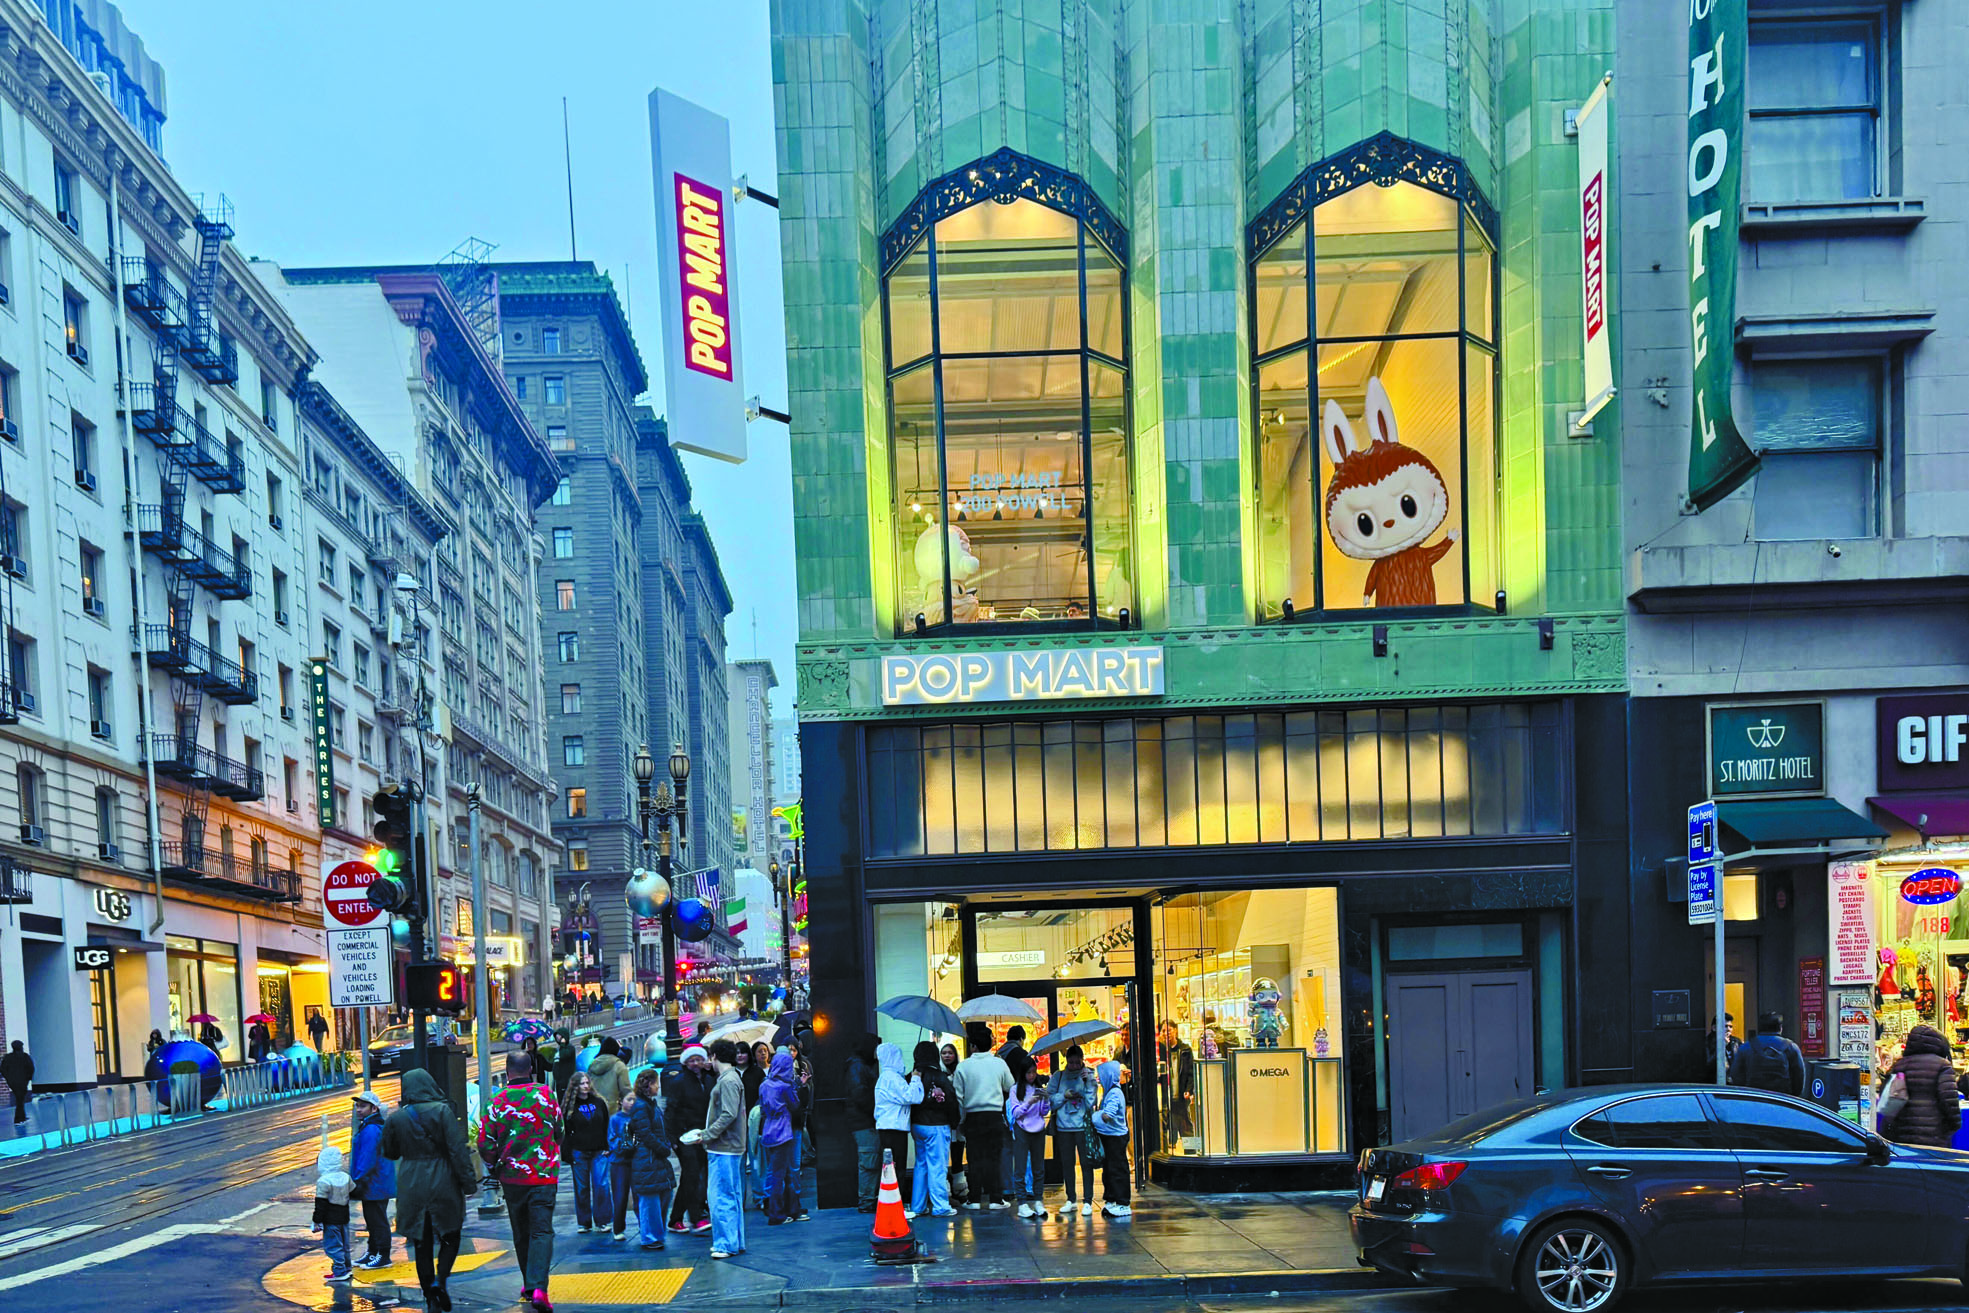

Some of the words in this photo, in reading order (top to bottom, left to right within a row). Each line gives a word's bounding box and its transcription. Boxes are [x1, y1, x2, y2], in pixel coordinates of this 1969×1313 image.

[1585, 180, 1599, 240] POP
[681, 182, 724, 295] MART
[1688, 32, 1728, 452] HOTEL
[1586, 244, 1601, 330] MART
[688, 294, 728, 373] POP
[969, 472, 1006, 490] POP
[1010, 470, 1063, 488] MART
[961, 494, 992, 512] 200
[997, 492, 1072, 511] POWELL
[884, 654, 990, 702] POP
[1010, 649, 1160, 697] MART
[316, 683, 325, 717] THE
[1897, 714, 1969, 764] GIF
[318, 726, 329, 799] BARNES
[1720, 760, 1736, 782] ST.
[1737, 758, 1777, 781] MORITZ
[1779, 756, 1815, 780] HOTEL
[752, 796, 765, 854] HOTEL
[1690, 813, 1699, 825] Pay
[1700, 809, 1713, 820] here
[332, 874, 348, 885] DO
[354, 872, 376, 885] NOT
[1690, 872, 1699, 883] Pay
[1700, 870, 1708, 881] by
[1690, 881, 1709, 892] License
[1902, 876, 1957, 897] OPEN
[93, 888, 132, 923] UGG
[1690, 891, 1704, 902] Plate
[338, 902, 374, 914] ENTER
[1921, 916, 1950, 934] 188
[343, 931, 371, 940] EXCEPT
[337, 941, 379, 951] COMMERCIAL
[485, 946, 504, 955] ALACE
[76, 949, 110, 967] UGG
[341, 952, 376, 961] VEHICLES
[1001, 952, 1040, 963] CASHIER
[352, 962, 367, 971] AND
[342, 972, 378, 982] VEHICLES
[438, 970, 454, 1000] 2
[346, 983, 375, 993] LOADING
[341, 995, 351, 1004] ON
[355, 994, 381, 1003] POWELL
